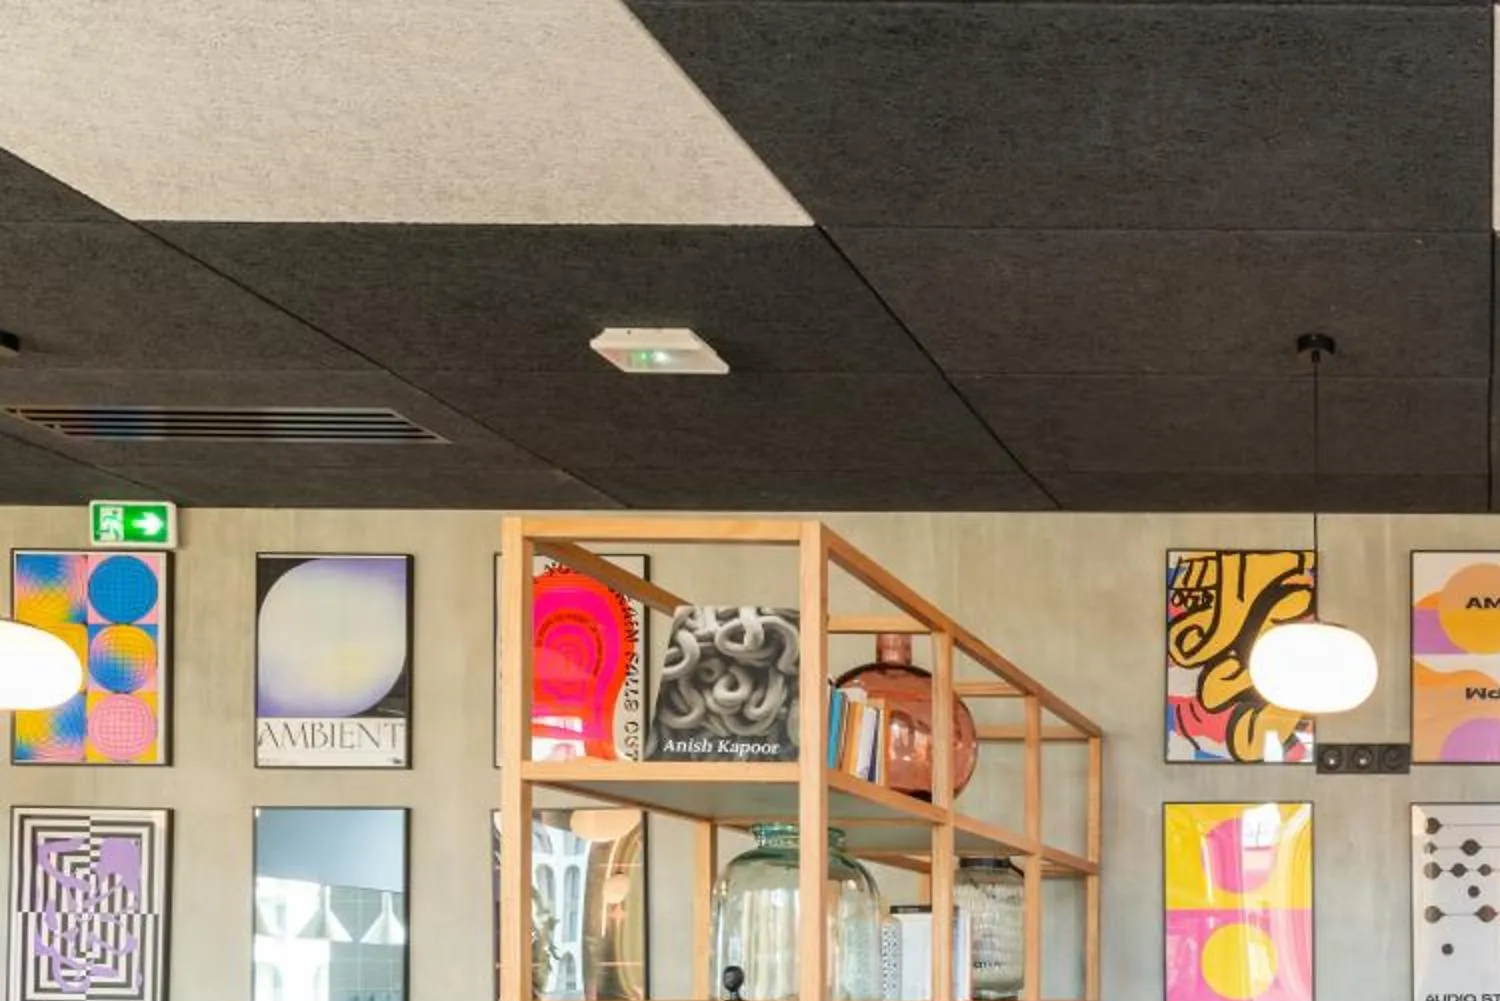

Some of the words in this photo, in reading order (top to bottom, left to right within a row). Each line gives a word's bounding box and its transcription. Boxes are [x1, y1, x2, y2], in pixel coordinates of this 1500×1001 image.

[257, 721, 405, 749] AMBIENT
[663, 738, 713, 753] Anish
[718, 739, 780, 756] Kapoor
